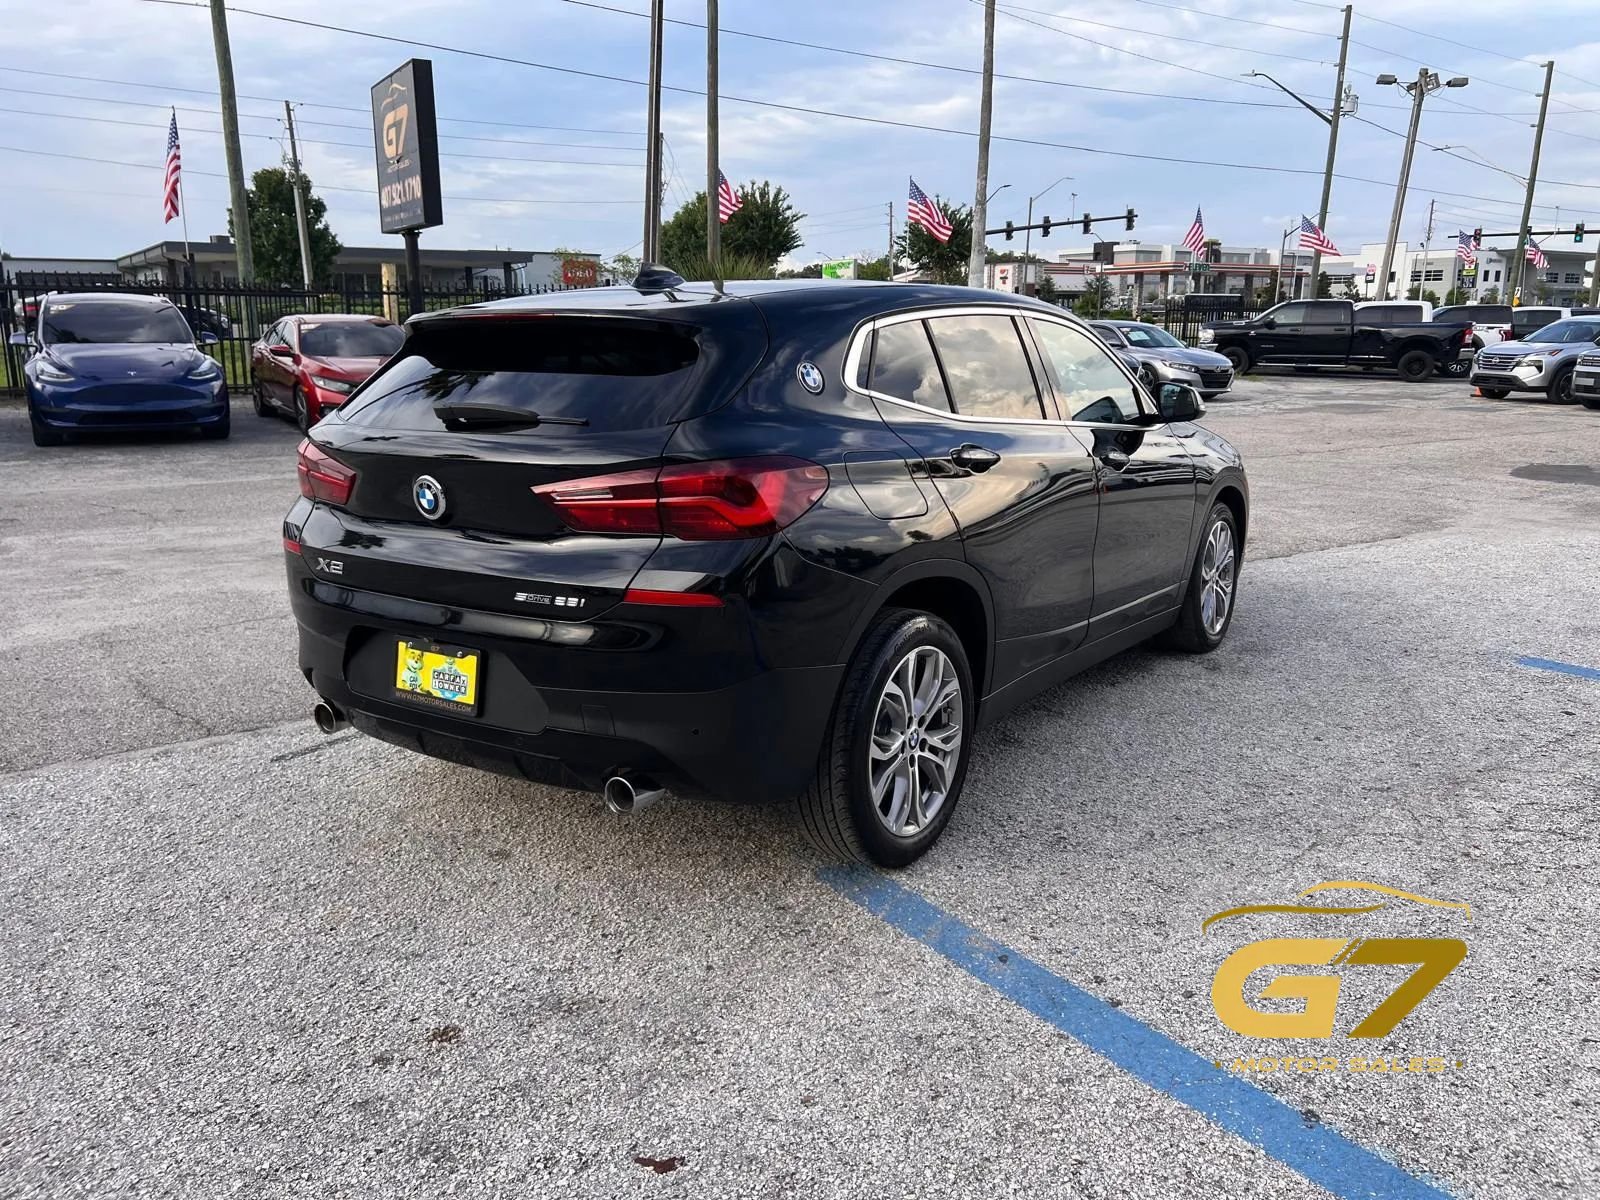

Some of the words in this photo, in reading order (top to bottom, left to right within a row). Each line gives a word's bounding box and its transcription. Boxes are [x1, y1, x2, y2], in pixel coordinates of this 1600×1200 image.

[383, 103, 409, 159] G7
[315, 557, 344, 575] X2
[433, 671, 467, 685] CARFAX
